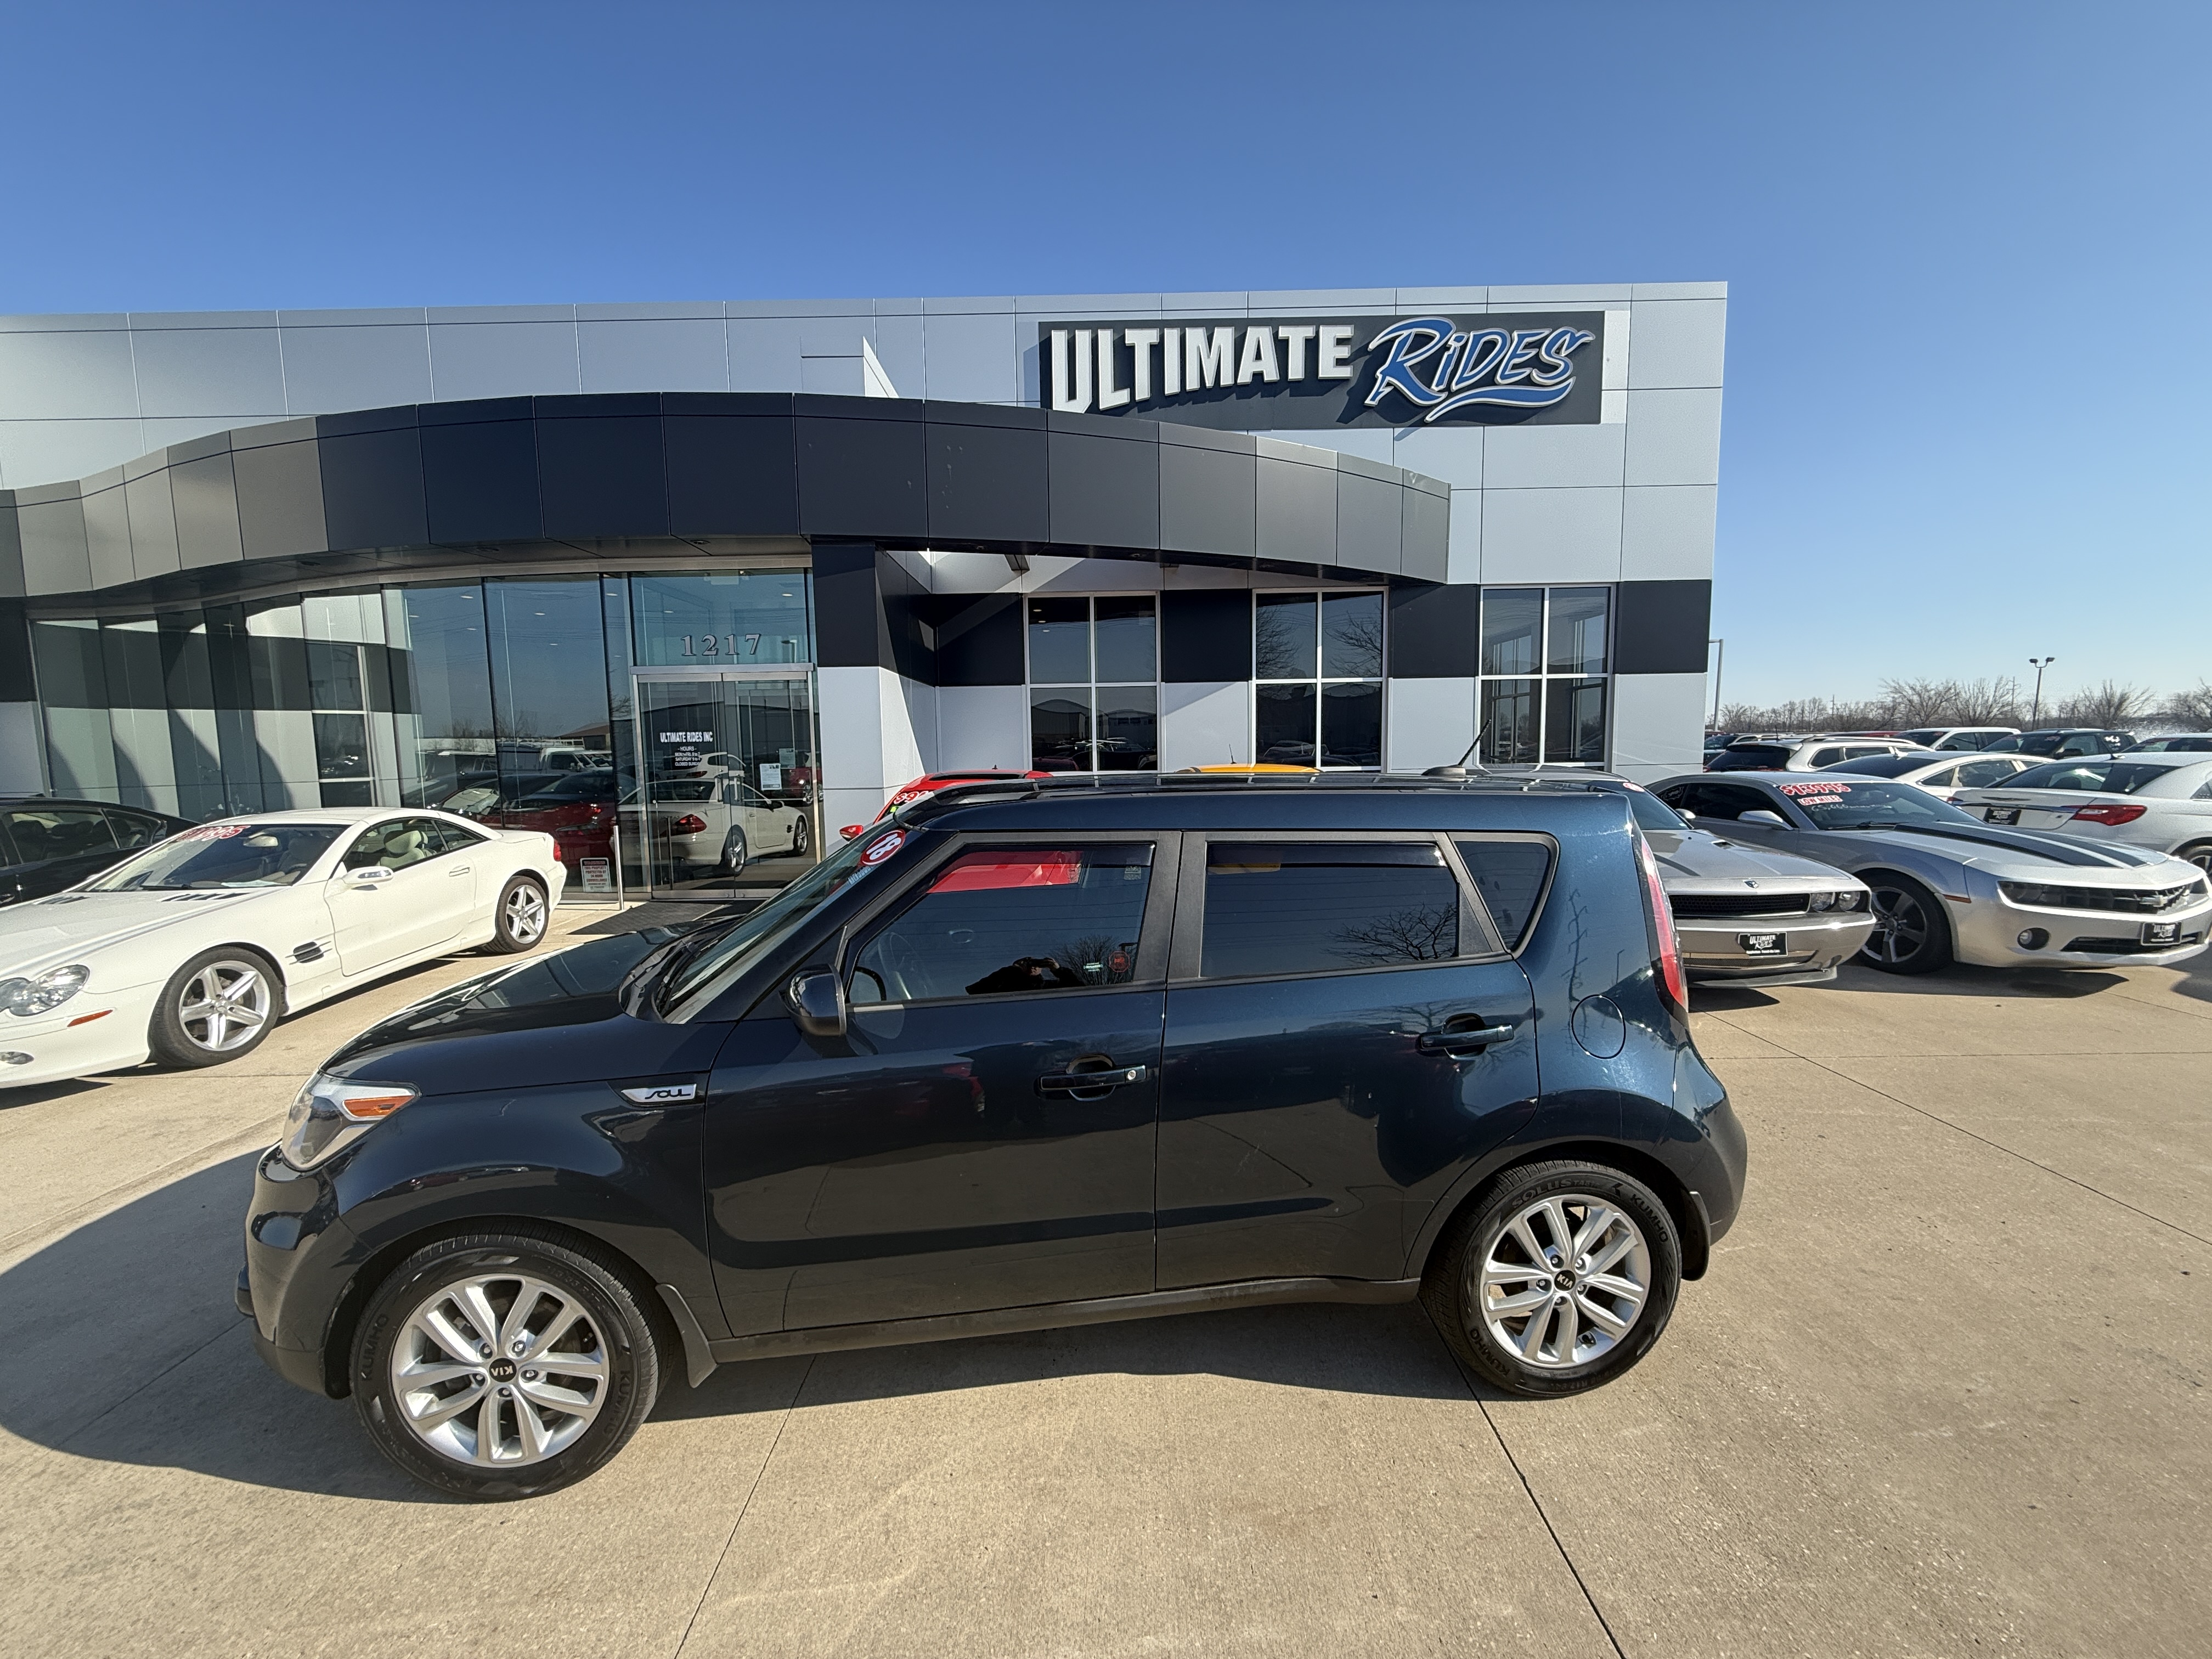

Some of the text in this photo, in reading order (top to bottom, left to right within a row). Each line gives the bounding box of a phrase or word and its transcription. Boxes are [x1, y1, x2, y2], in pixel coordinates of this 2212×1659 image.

[1052, 324, 1354, 413] ULTIMATE
[681, 634, 761, 657] 1217
[660, 732, 713, 742] ULTIMATE RIDES INC
[1780, 783, 1852, 795] $13995
[866, 833, 901, 860] 18
[1750, 934, 1776, 945] ULTIMATE
[645, 1088, 691, 1100] SOUL
[1512, 1179, 1572, 1207] SOLUS
[1630, 1194, 1668, 1243] KUMHO
[1557, 1274, 1573, 1289] KIA
[1470, 1328, 1510, 1376] KUMHO
[490, 1365, 514, 1376] KIA
